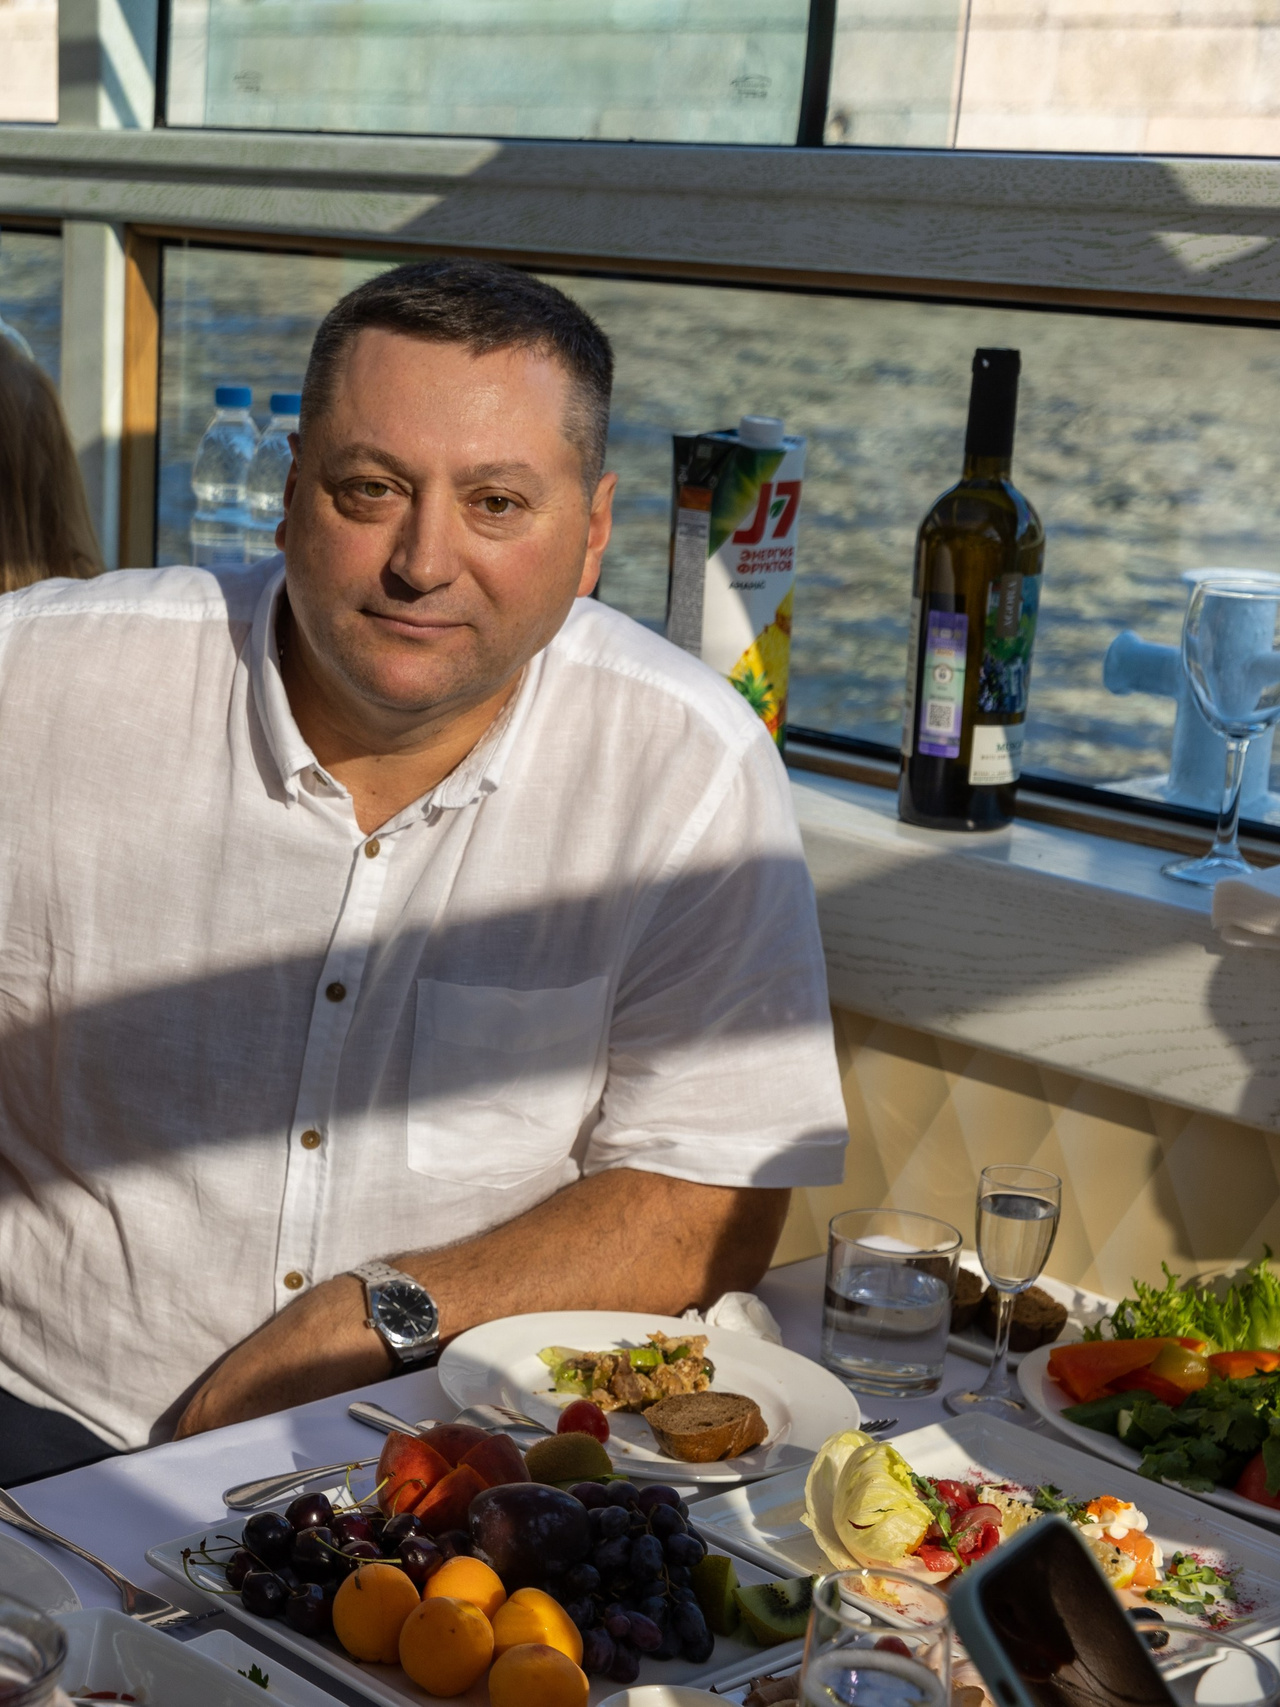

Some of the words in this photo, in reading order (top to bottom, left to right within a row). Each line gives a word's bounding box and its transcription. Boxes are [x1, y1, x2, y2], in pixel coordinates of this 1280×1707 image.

[732, 481, 801, 545] J7
[740, 547, 794, 561] ЭНЕРГИЯ
[737, 560, 794, 575] ФРУКТОВ
